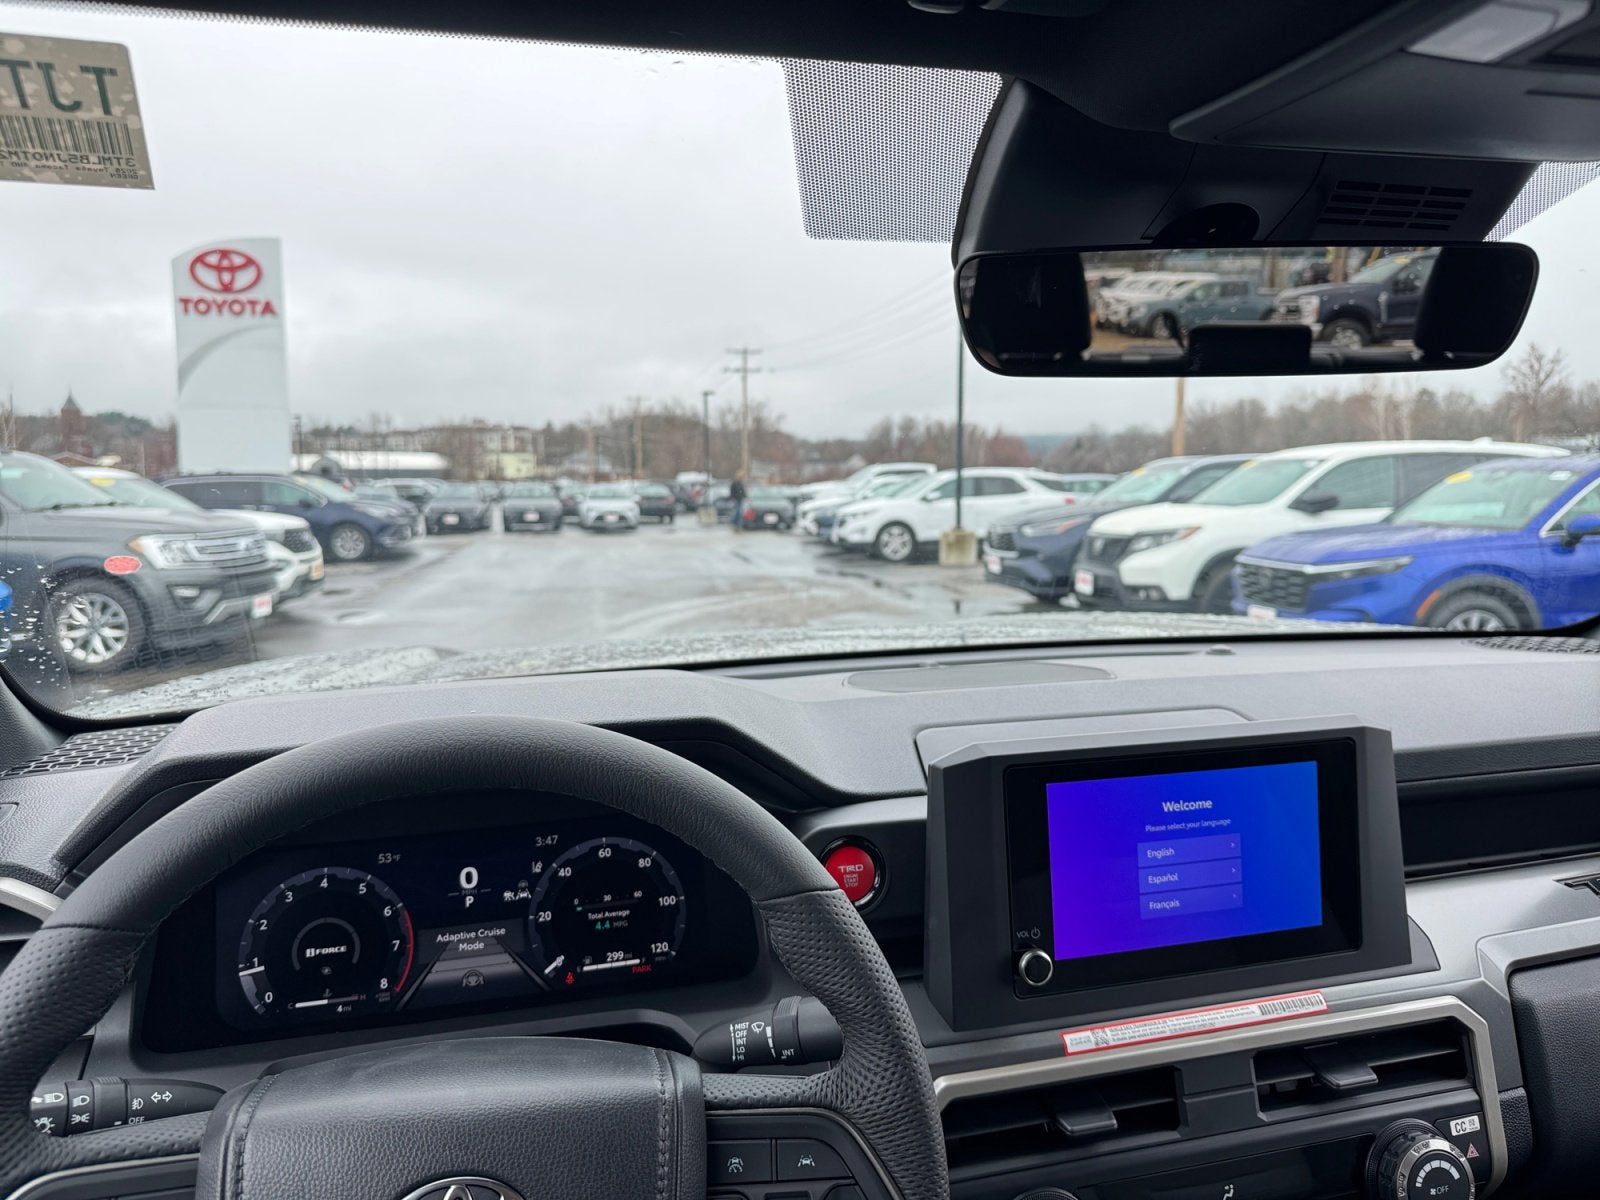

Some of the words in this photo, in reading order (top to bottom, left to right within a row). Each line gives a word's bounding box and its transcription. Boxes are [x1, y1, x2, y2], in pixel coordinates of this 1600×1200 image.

[179, 298, 277, 316] TOYOTA
[1162, 799, 1213, 813] Welcome
[1145, 824, 1167, 832] Please
[1167, 822, 1186, 830] select
[1186, 821, 1201, 830] your
[1201, 818, 1232, 828] language
[535, 835, 559, 847] 3:47
[598, 847, 612, 859] 60
[1147, 847, 1175, 859] English
[638, 857, 652, 868] 80
[837, 864, 864, 873] TRD
[459, 866, 479, 889] 0
[558, 866, 572, 878] 40
[320, 878, 329, 888] 4
[1148, 872, 1179, 885] Español
[358, 882, 367, 894] 5
[285, 891, 294, 902] 3
[465, 895, 474, 908] P
[658, 896, 677, 907] 100
[1149, 898, 1181, 910] Français
[383, 905, 392, 917] 6
[537, 911, 552, 922] 20
[587, 911, 604, 920] Total
[604, 909, 630, 918] Average
[259, 919, 268, 930] 2
[436, 931, 477, 943] Adaptive
[477, 927, 506, 938] Cruise
[1016, 930, 1029, 938] VOL
[391, 939, 401, 951] 7
[459, 940, 485, 952] Mode
[651, 942, 669, 954] 120
[252, 957, 260, 967] 1
[606, 951, 624, 962] 299
[632, 965, 652, 973] PARK
[380, 977, 388, 989] 8
[264, 991, 273, 1003] 0
[735, 1022, 749, 1030] MIST
[128, 1116, 145, 1125] OFF
[1454, 1121, 1467, 1133] CC
[1436, 1185, 1449, 1194] OFF
